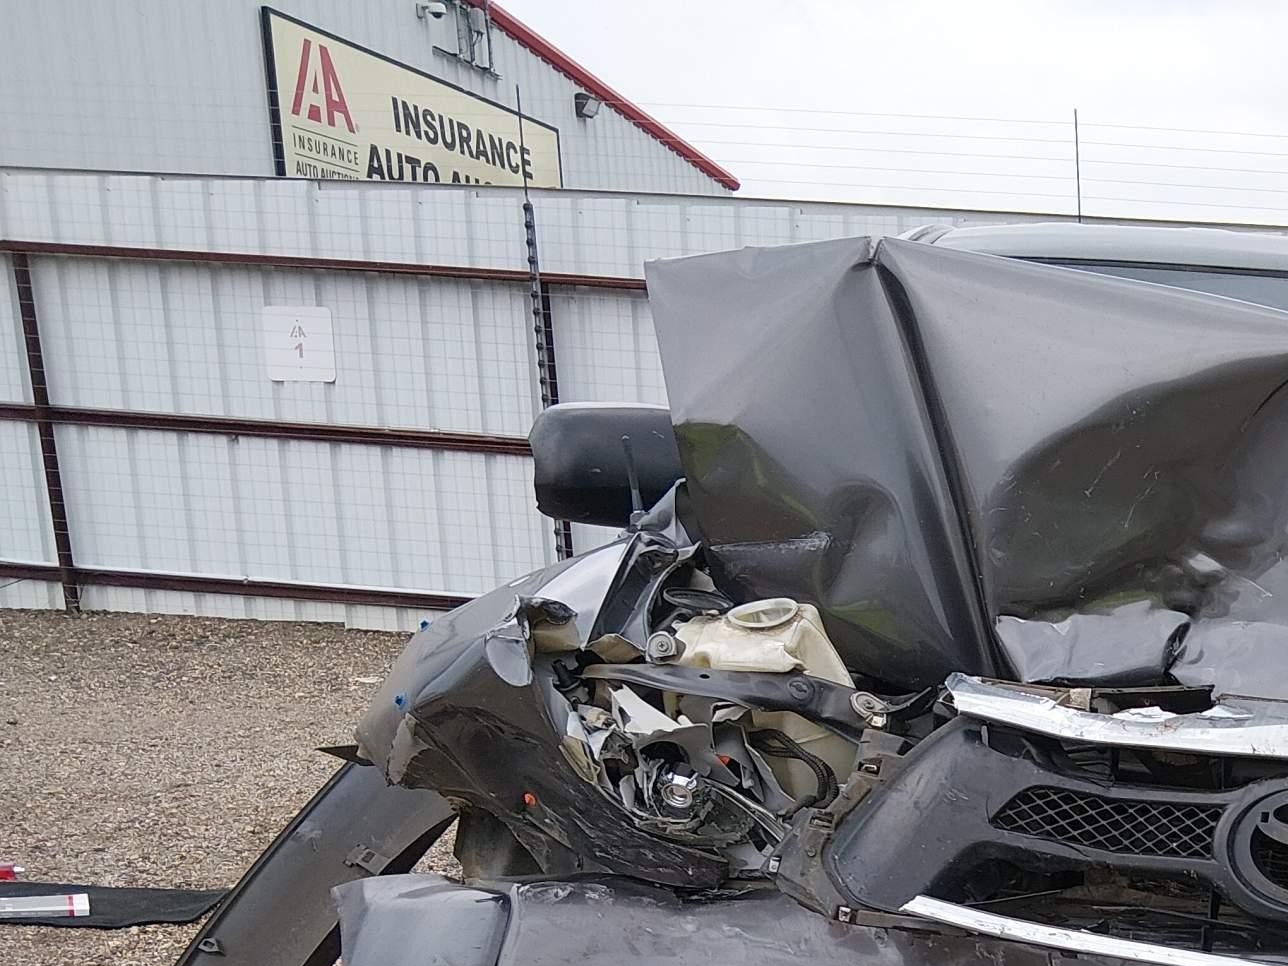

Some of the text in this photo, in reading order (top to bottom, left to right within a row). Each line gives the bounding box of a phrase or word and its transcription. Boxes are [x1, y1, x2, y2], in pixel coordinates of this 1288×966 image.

[293, 132, 359, 166] INSURANCE
[391, 95, 534, 181] INSURANCE
[296, 160, 319, 178] AUTO
[366, 144, 441, 183] AUTO
[294, 342, 304, 358] 1
